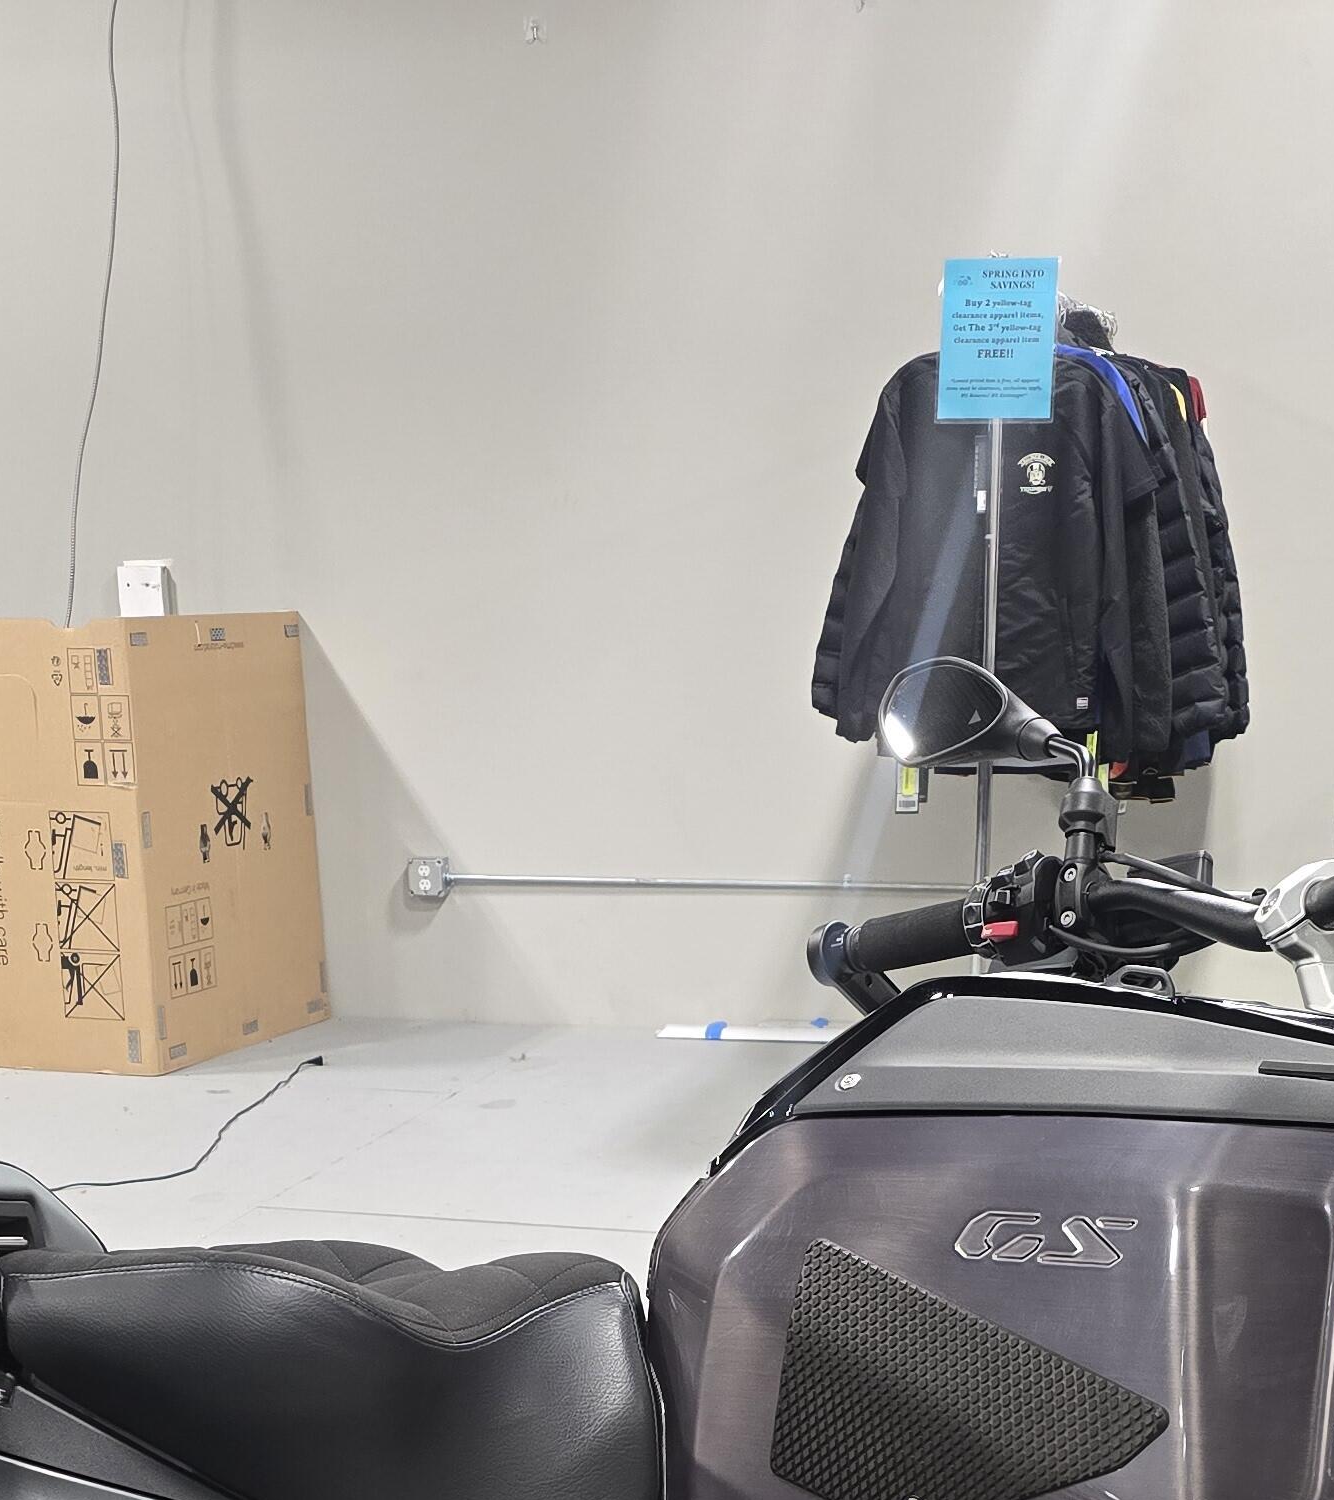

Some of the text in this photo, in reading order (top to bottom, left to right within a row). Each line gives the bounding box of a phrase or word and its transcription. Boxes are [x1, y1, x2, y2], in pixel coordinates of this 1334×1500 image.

[982, 269, 1044, 278] SPRING INTO
[990, 280, 1035, 289] SAVINGS!
[965, 299, 983, 308] Buy
[992, 300, 1032, 308] yellow-tag
[990, 312, 1017, 320] apparel
[1001, 325, 1041, 333] yellow-tag
[991, 337, 1019, 345] apparel
[977, 349, 1014, 358] FREE!!
[954, 1211, 1138, 1269] GS
